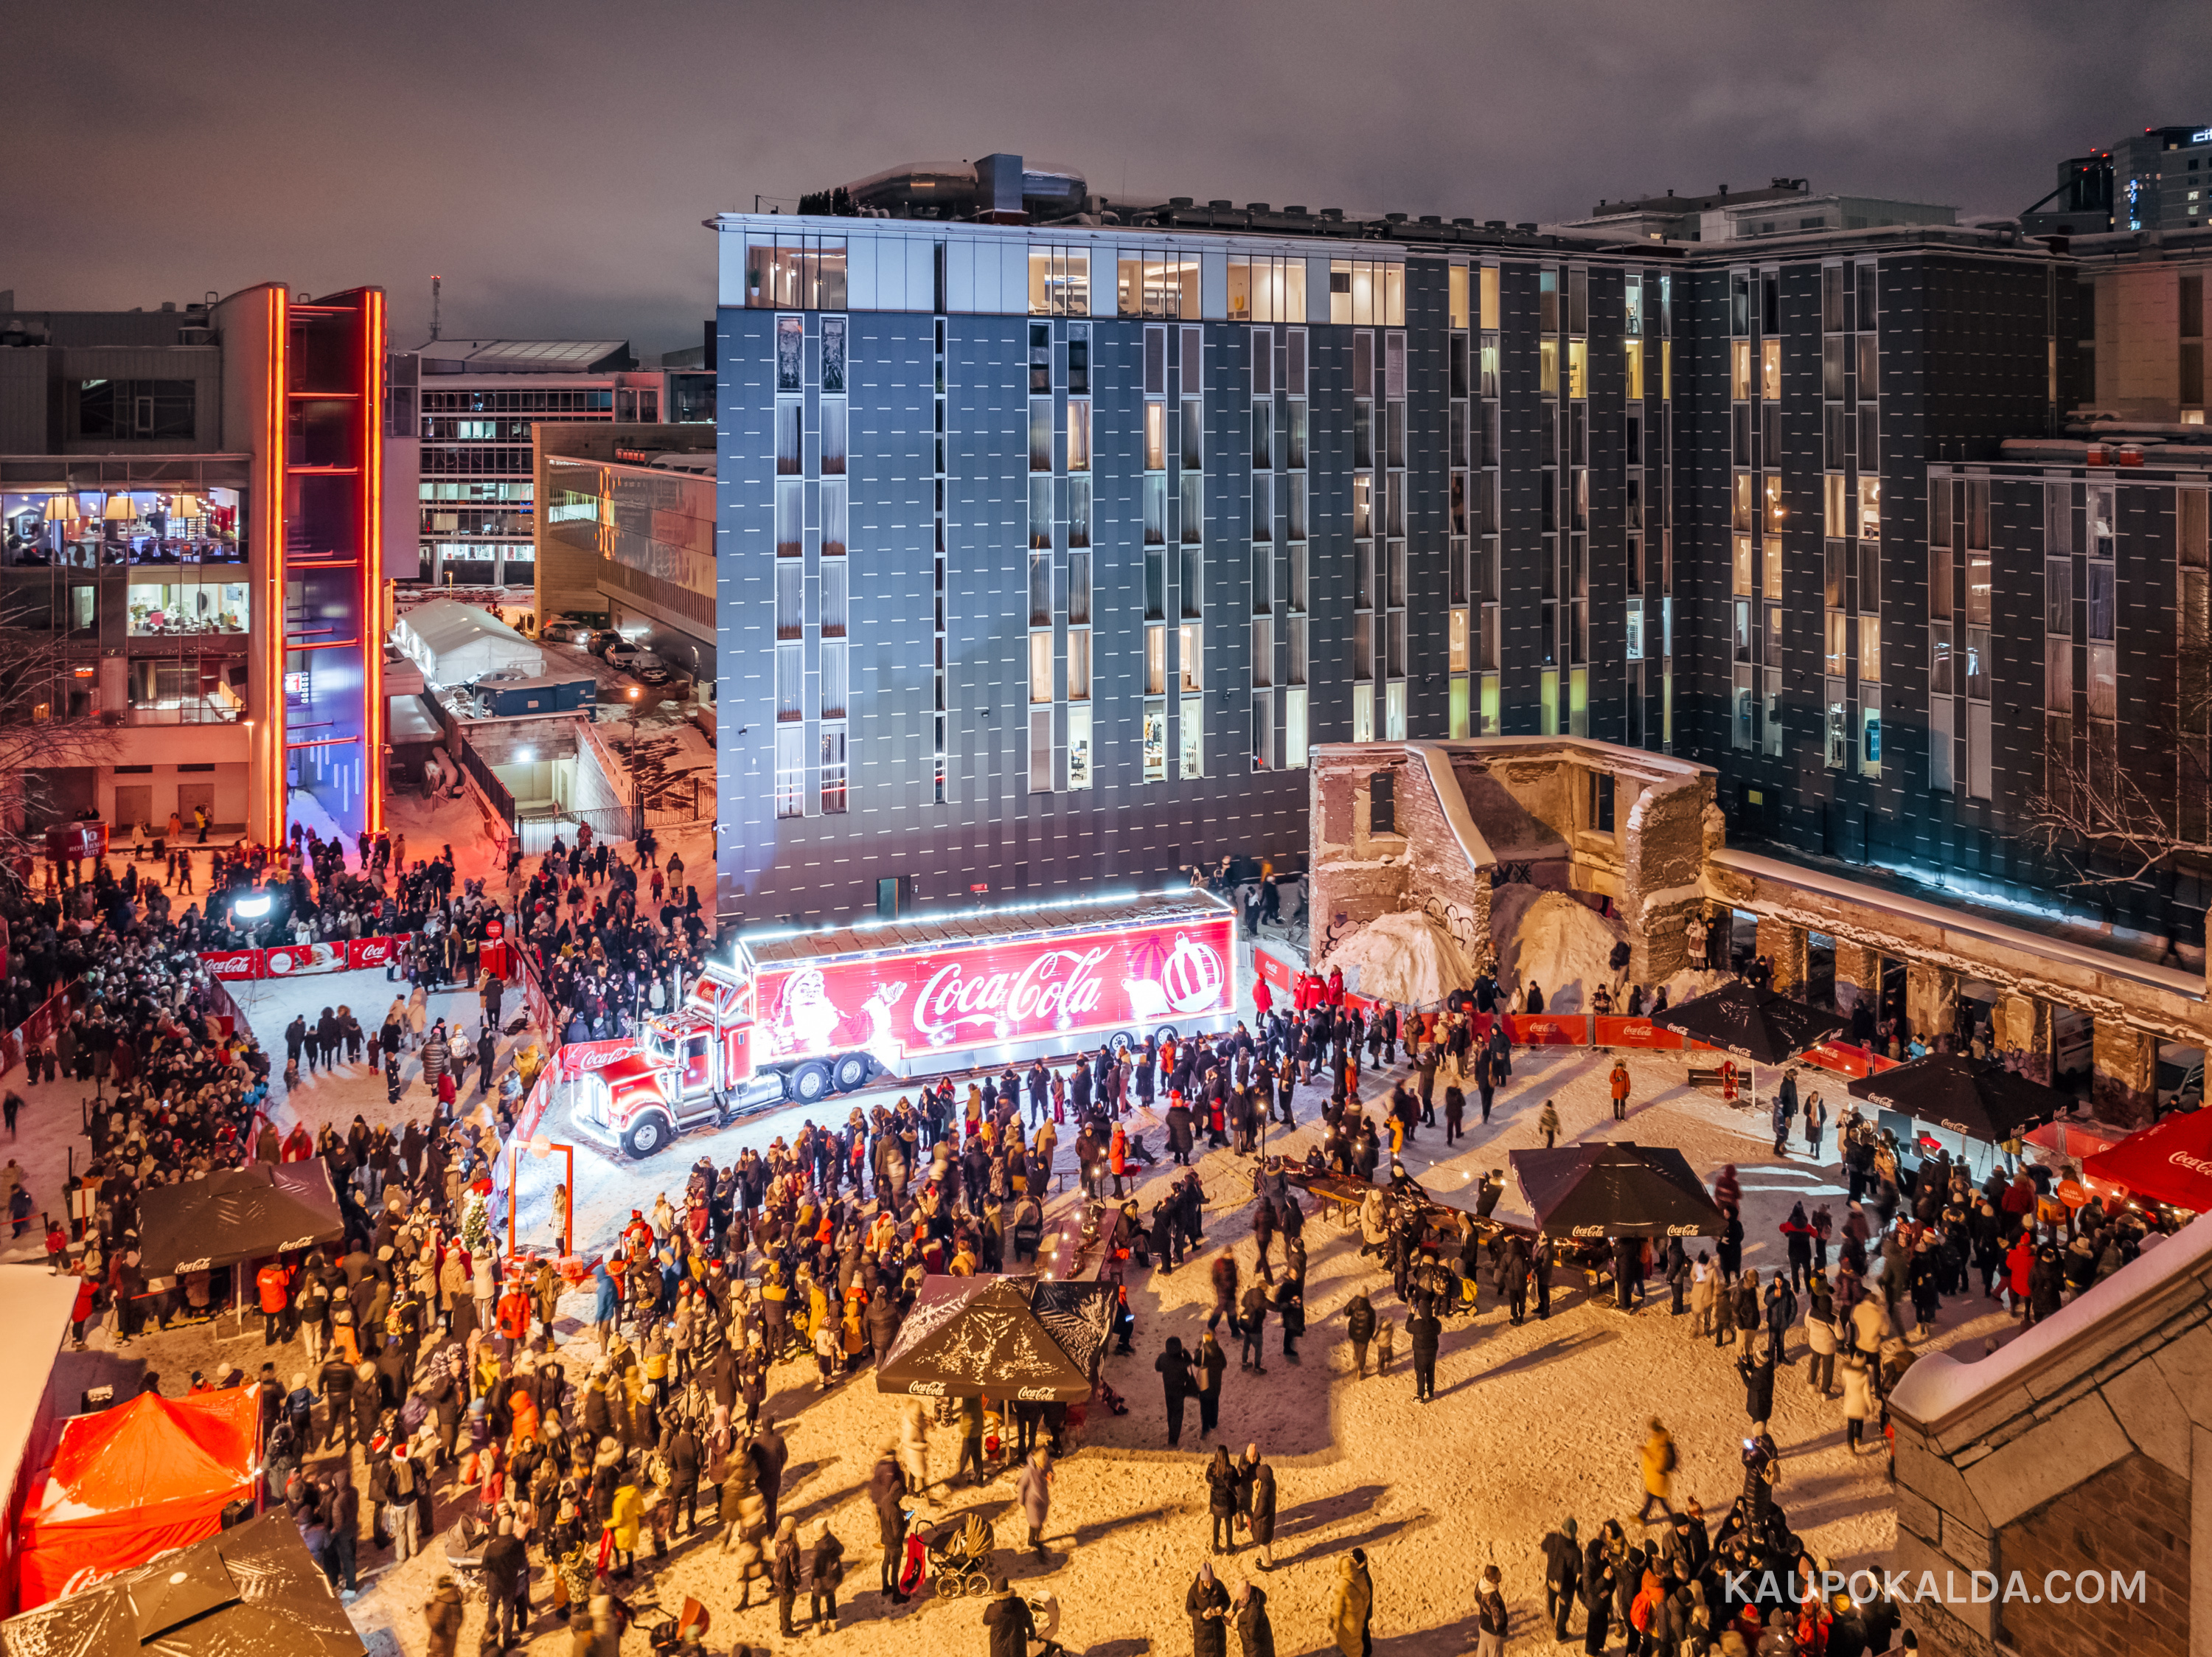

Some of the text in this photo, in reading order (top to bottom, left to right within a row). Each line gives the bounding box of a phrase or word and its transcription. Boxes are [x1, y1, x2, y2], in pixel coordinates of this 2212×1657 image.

[913, 945, 1114, 1033] Coca-Cola
[1572, 1226, 1604, 1237] Coca-Cola
[1667, 1225, 1700, 1237] Coca-Cola
[909, 1380, 947, 1396] Coca-Cola
[1018, 1386, 1057, 1400] Coca-Cola
